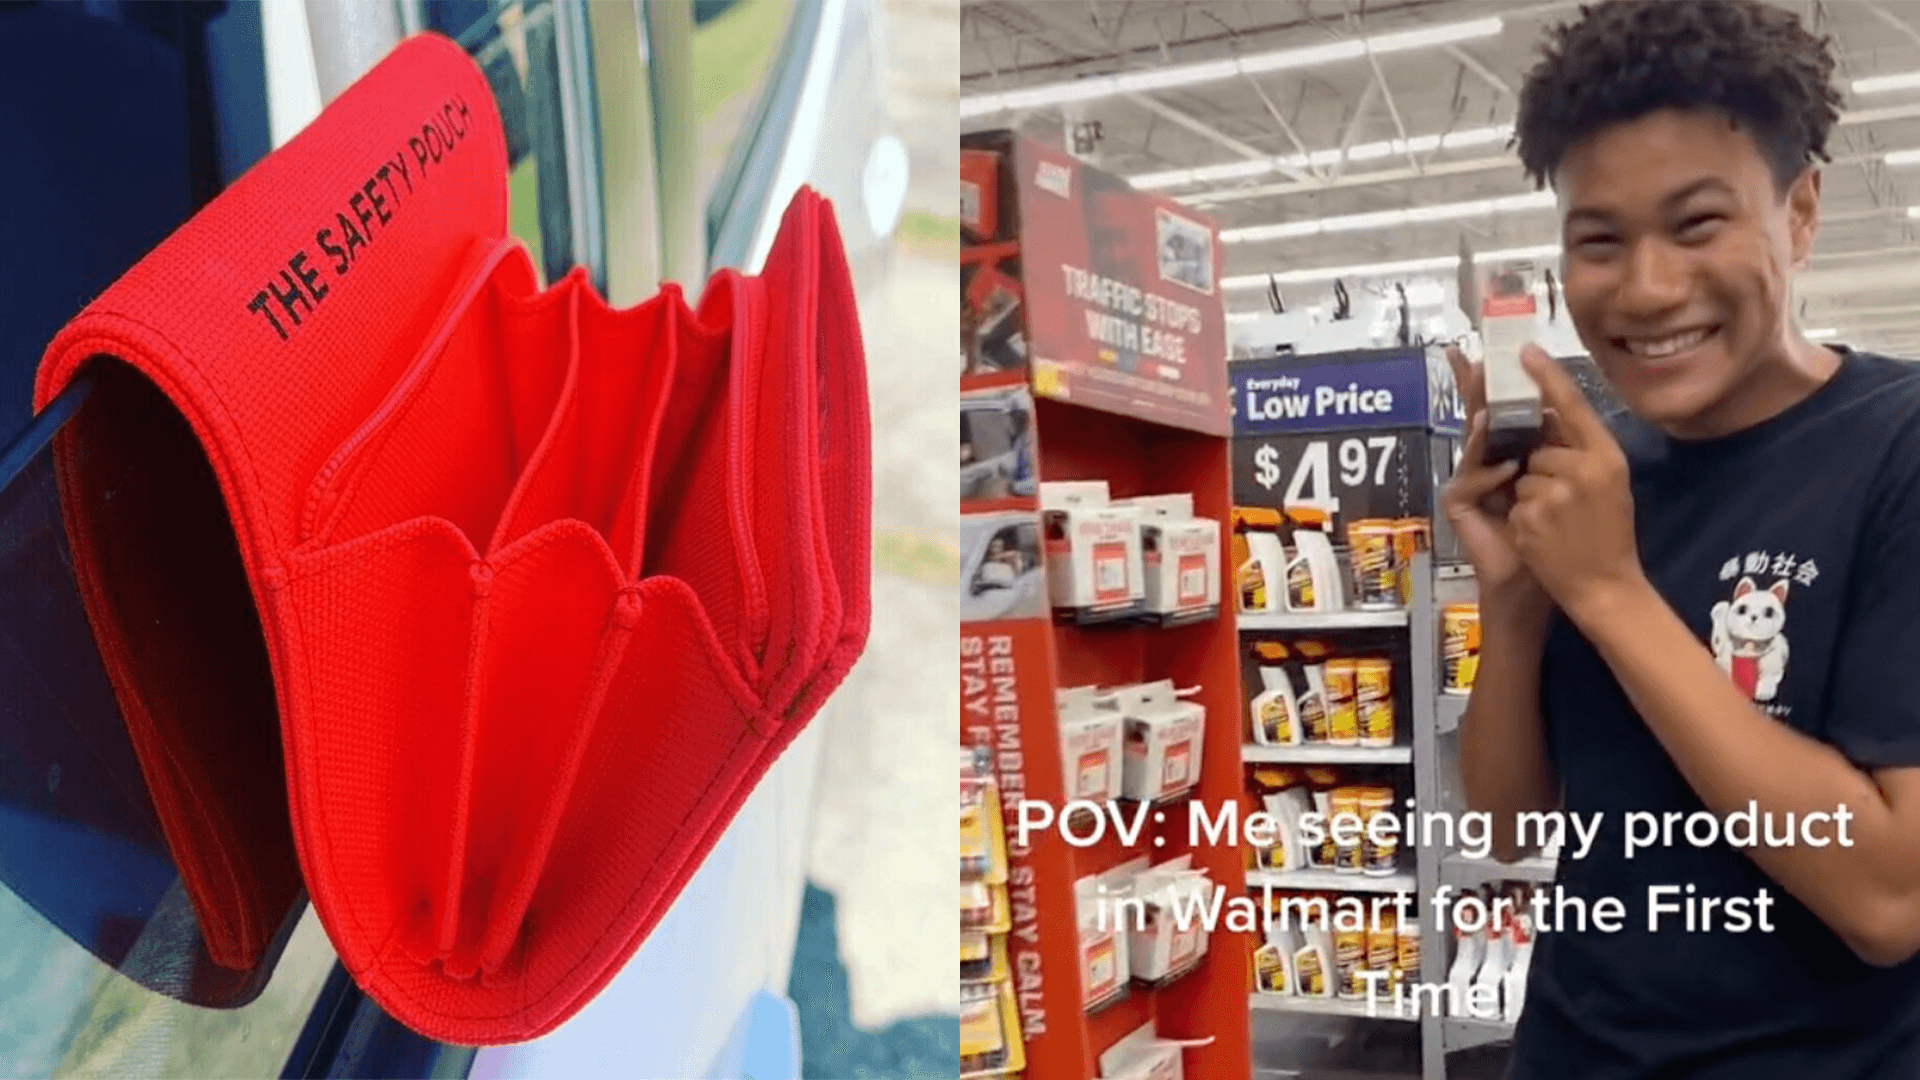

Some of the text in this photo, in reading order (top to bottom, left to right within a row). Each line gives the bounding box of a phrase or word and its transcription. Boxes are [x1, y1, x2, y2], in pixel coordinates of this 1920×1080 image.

[247, 92, 475, 341] THE SAFETY POUCH
[1061, 263, 1202, 335] TRAFFIC STOPS
[1085, 308, 1187, 365] WITH EASE
[1246, 375, 1301, 392] Everyday
[1247, 391, 1310, 420] Low
[1315, 382, 1393, 417] Price
[960, 635, 990, 715] STAY
[988, 635, 1026, 811] REMEMBER
[1010, 865, 1039, 943] STAY
